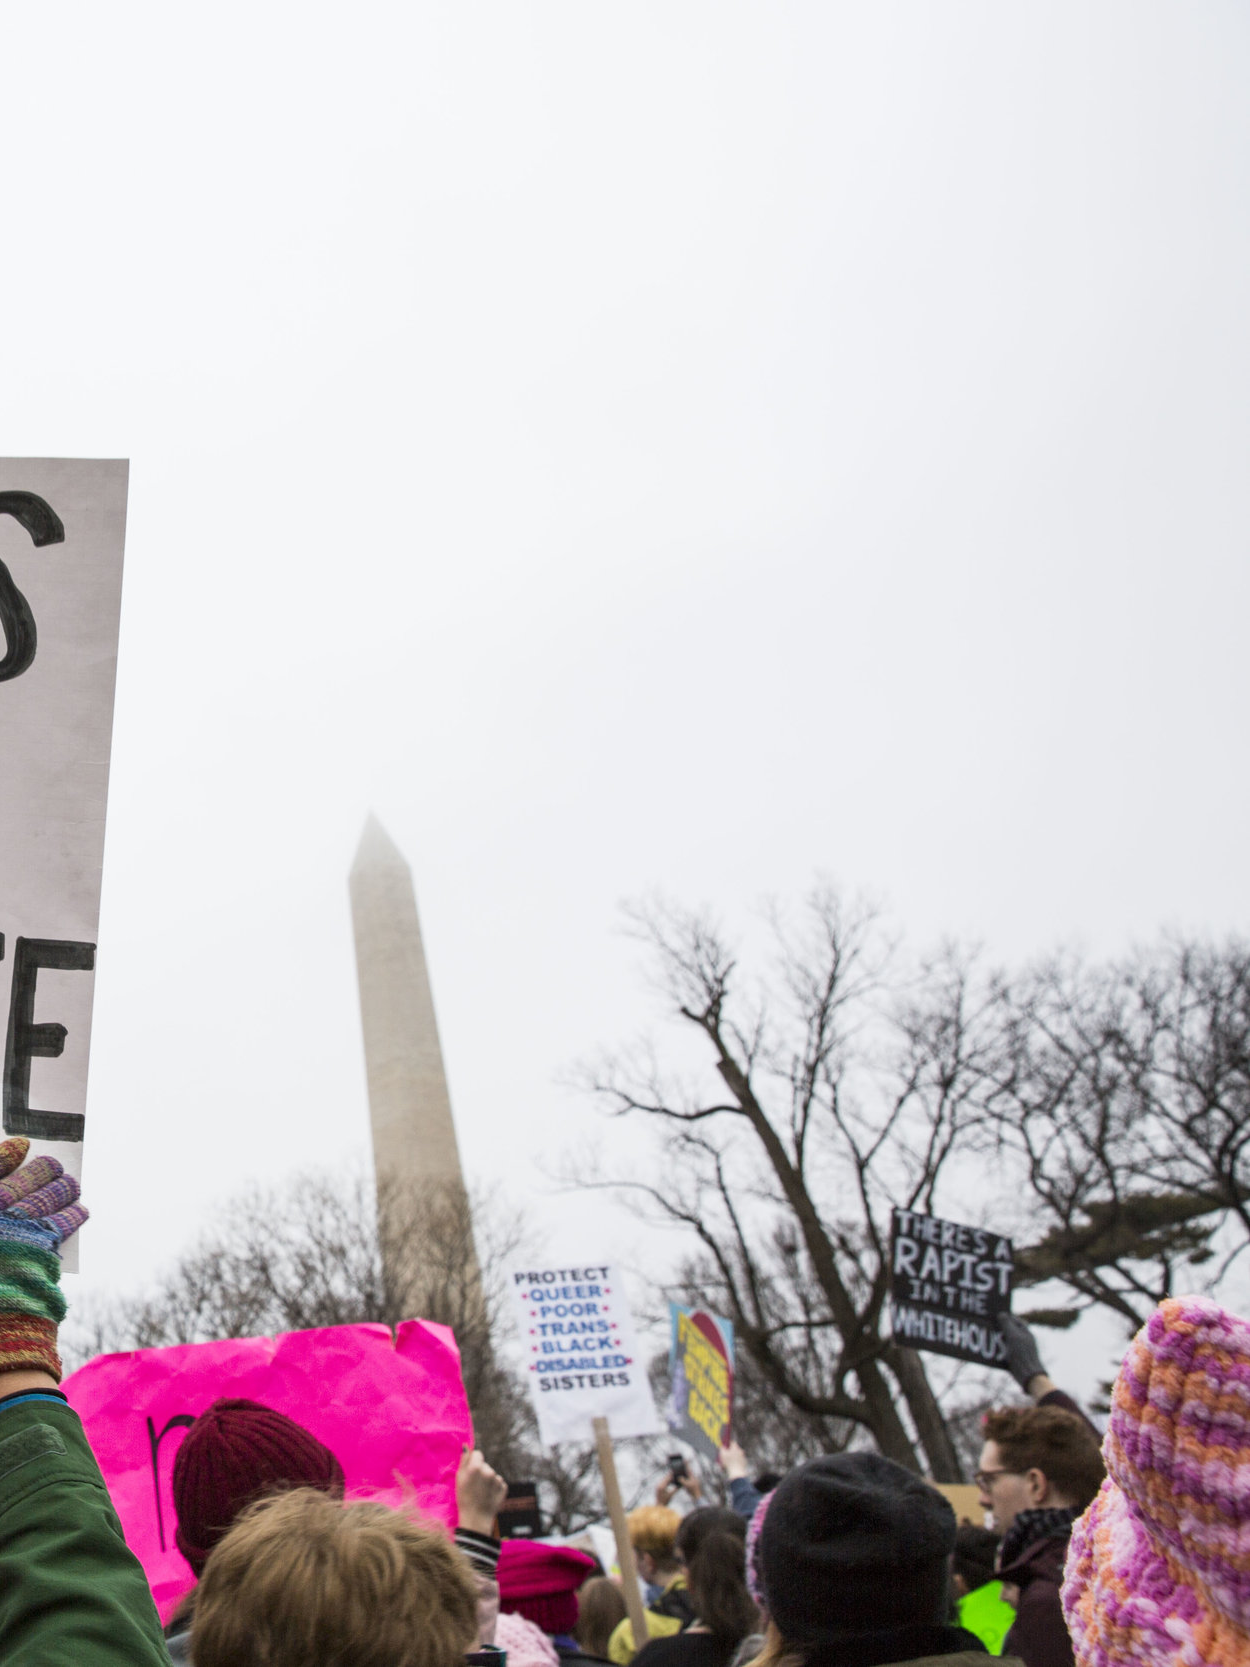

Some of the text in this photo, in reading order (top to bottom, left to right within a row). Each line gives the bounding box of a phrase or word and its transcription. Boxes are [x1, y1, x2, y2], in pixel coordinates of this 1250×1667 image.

[994, 1240, 1011, 1260] A
[893, 1236, 1014, 1296] RAPIST
[514, 1267, 609, 1285] PROTECT
[530, 1285, 602, 1302] QUEER
[908, 1280, 987, 1315] IN THE
[540, 1303, 599, 1318] POOR
[537, 1320, 609, 1336] TRANS
[541, 1337, 612, 1354] BLACK
[536, 1355, 627, 1373] DISABLED
[539, 1372, 630, 1392] SISTERS
